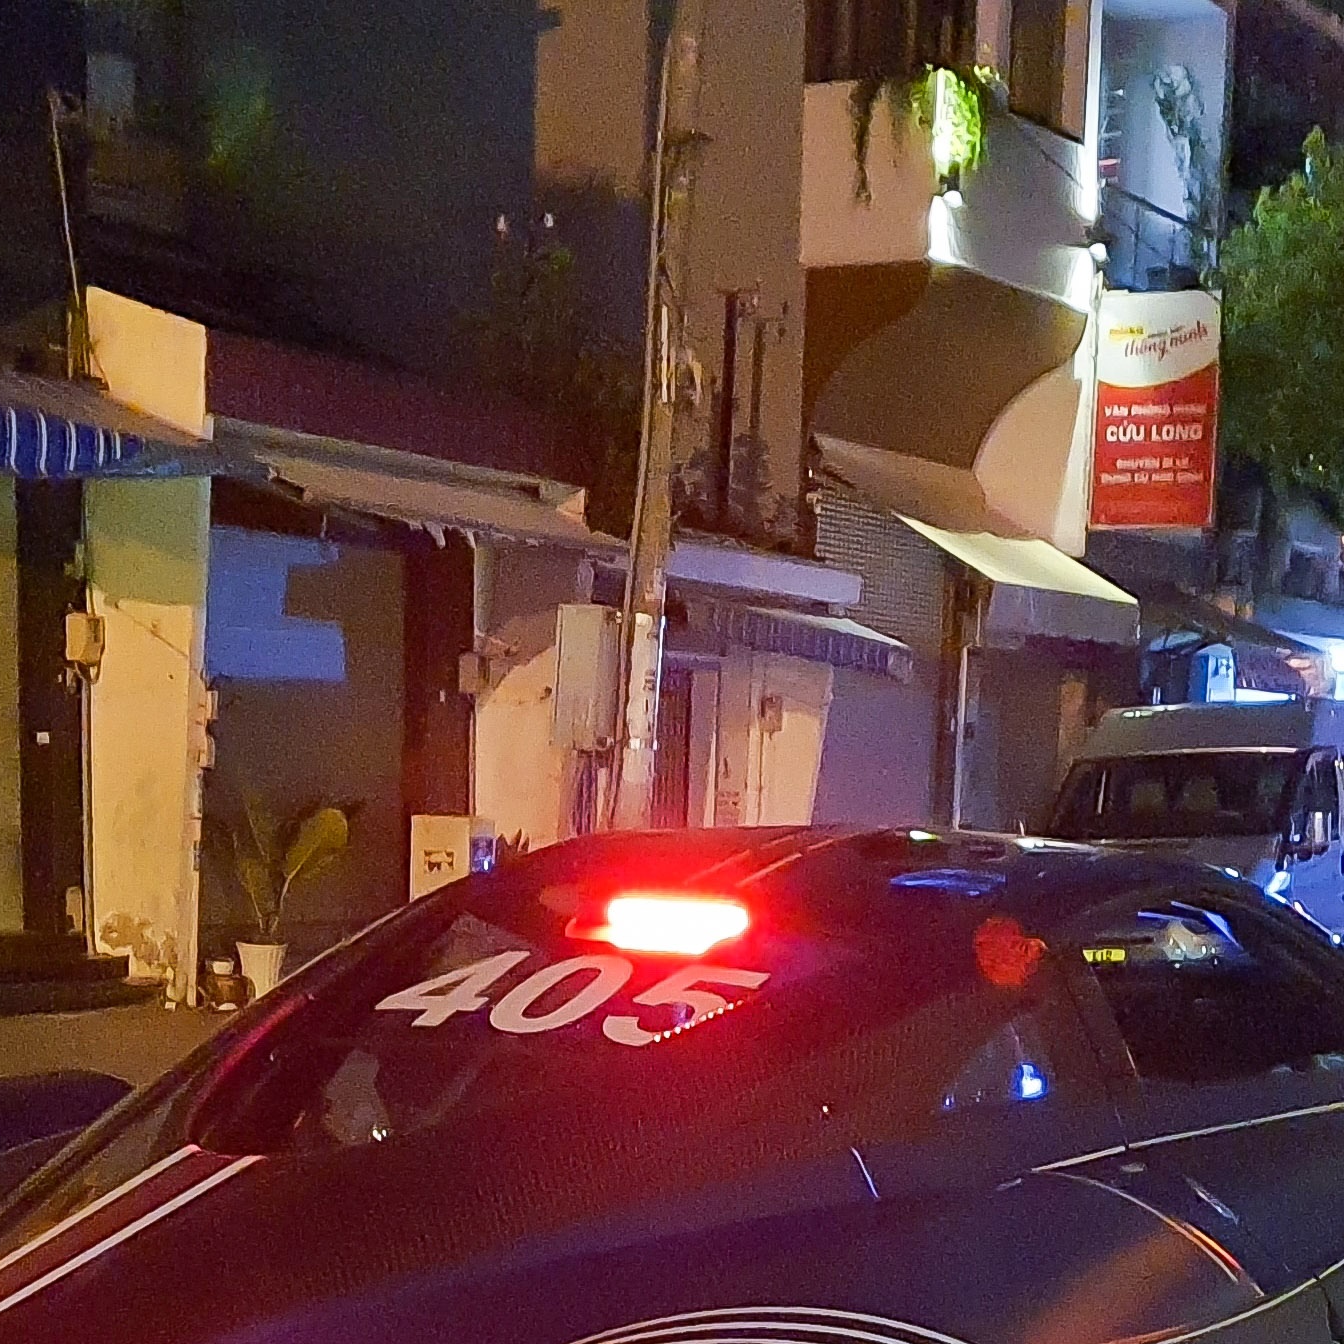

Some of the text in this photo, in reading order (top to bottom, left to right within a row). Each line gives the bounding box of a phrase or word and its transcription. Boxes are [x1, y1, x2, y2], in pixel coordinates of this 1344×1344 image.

[1106, 420, 1203, 442] CỬU LONG
[374, 949, 772, 1047] 405
